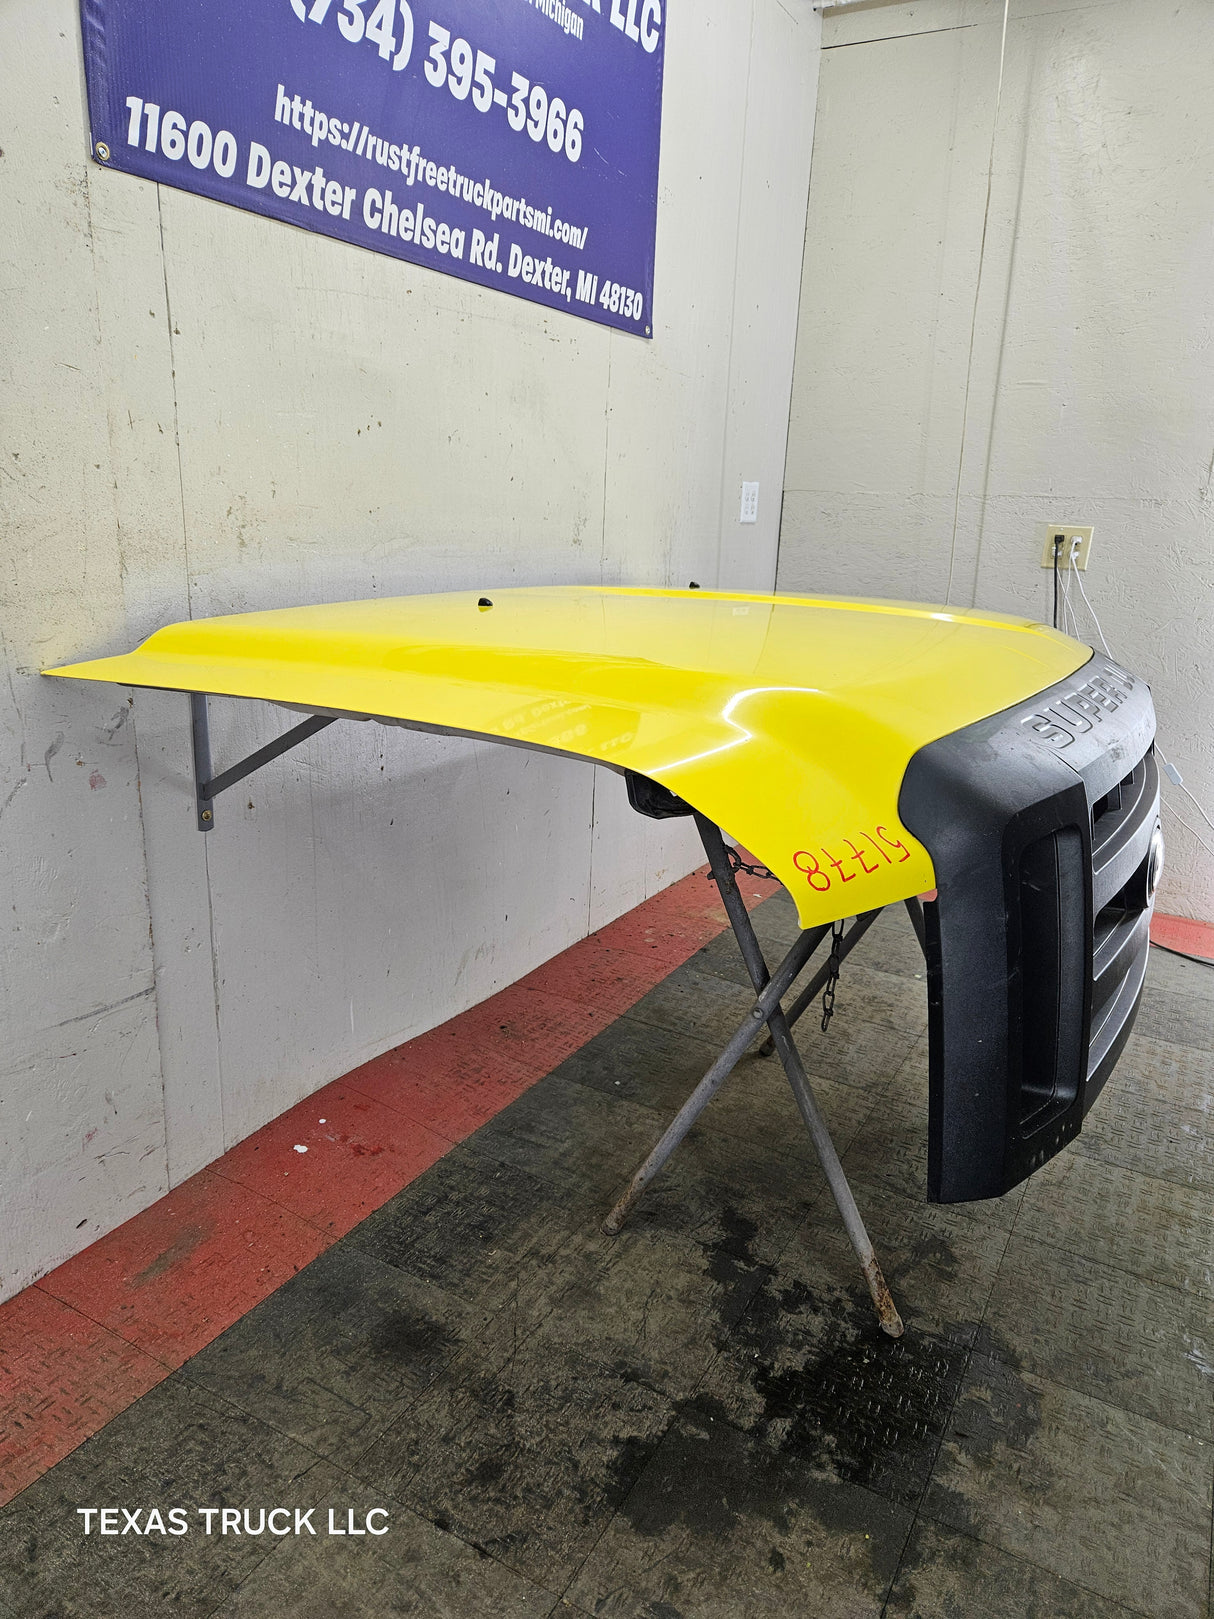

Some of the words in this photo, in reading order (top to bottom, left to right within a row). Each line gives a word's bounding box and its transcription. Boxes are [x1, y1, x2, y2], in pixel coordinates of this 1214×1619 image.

[424, 20, 584, 163] 395-3966
[126, 96, 238, 178] 11600
[246, 141, 357, 221] Dexter
[363, 187, 466, 260] Chelsea
[470, 228, 503, 273] Rd.
[507, 242, 572, 304] Dexter,
[599, 279, 643, 321] 48130
[274, 84, 588, 250] https://rustfreetruckpartsmi.com/
[1020, 674, 1128, 749] SUPER
[793, 826, 910, 892] 51778
